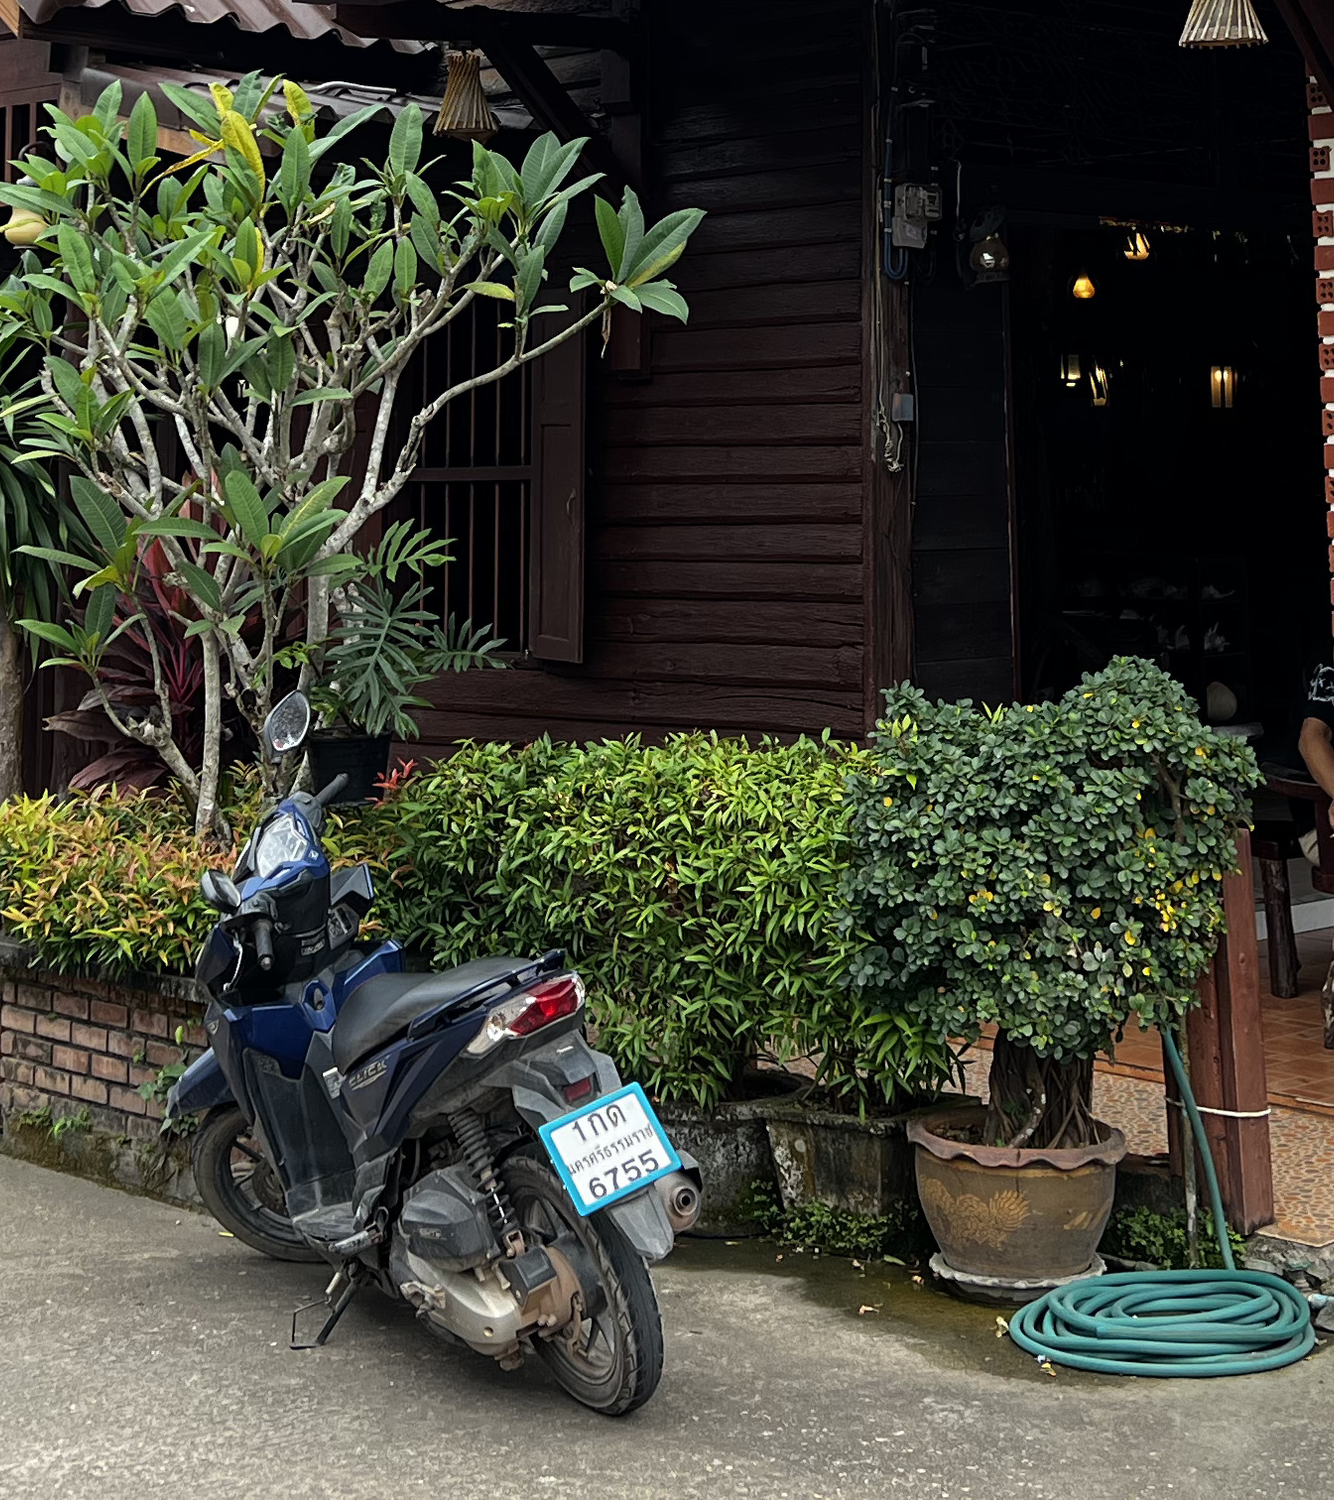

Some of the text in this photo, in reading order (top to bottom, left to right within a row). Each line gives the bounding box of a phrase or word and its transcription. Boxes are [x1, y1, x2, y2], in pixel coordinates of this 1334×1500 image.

[348, 1056, 388, 1087] CLICK
[572, 1104, 627, 1142] 1กด
[568, 1123, 654, 1175] นครศรีธรรมราช
[589, 1149, 659, 1199] 6755
